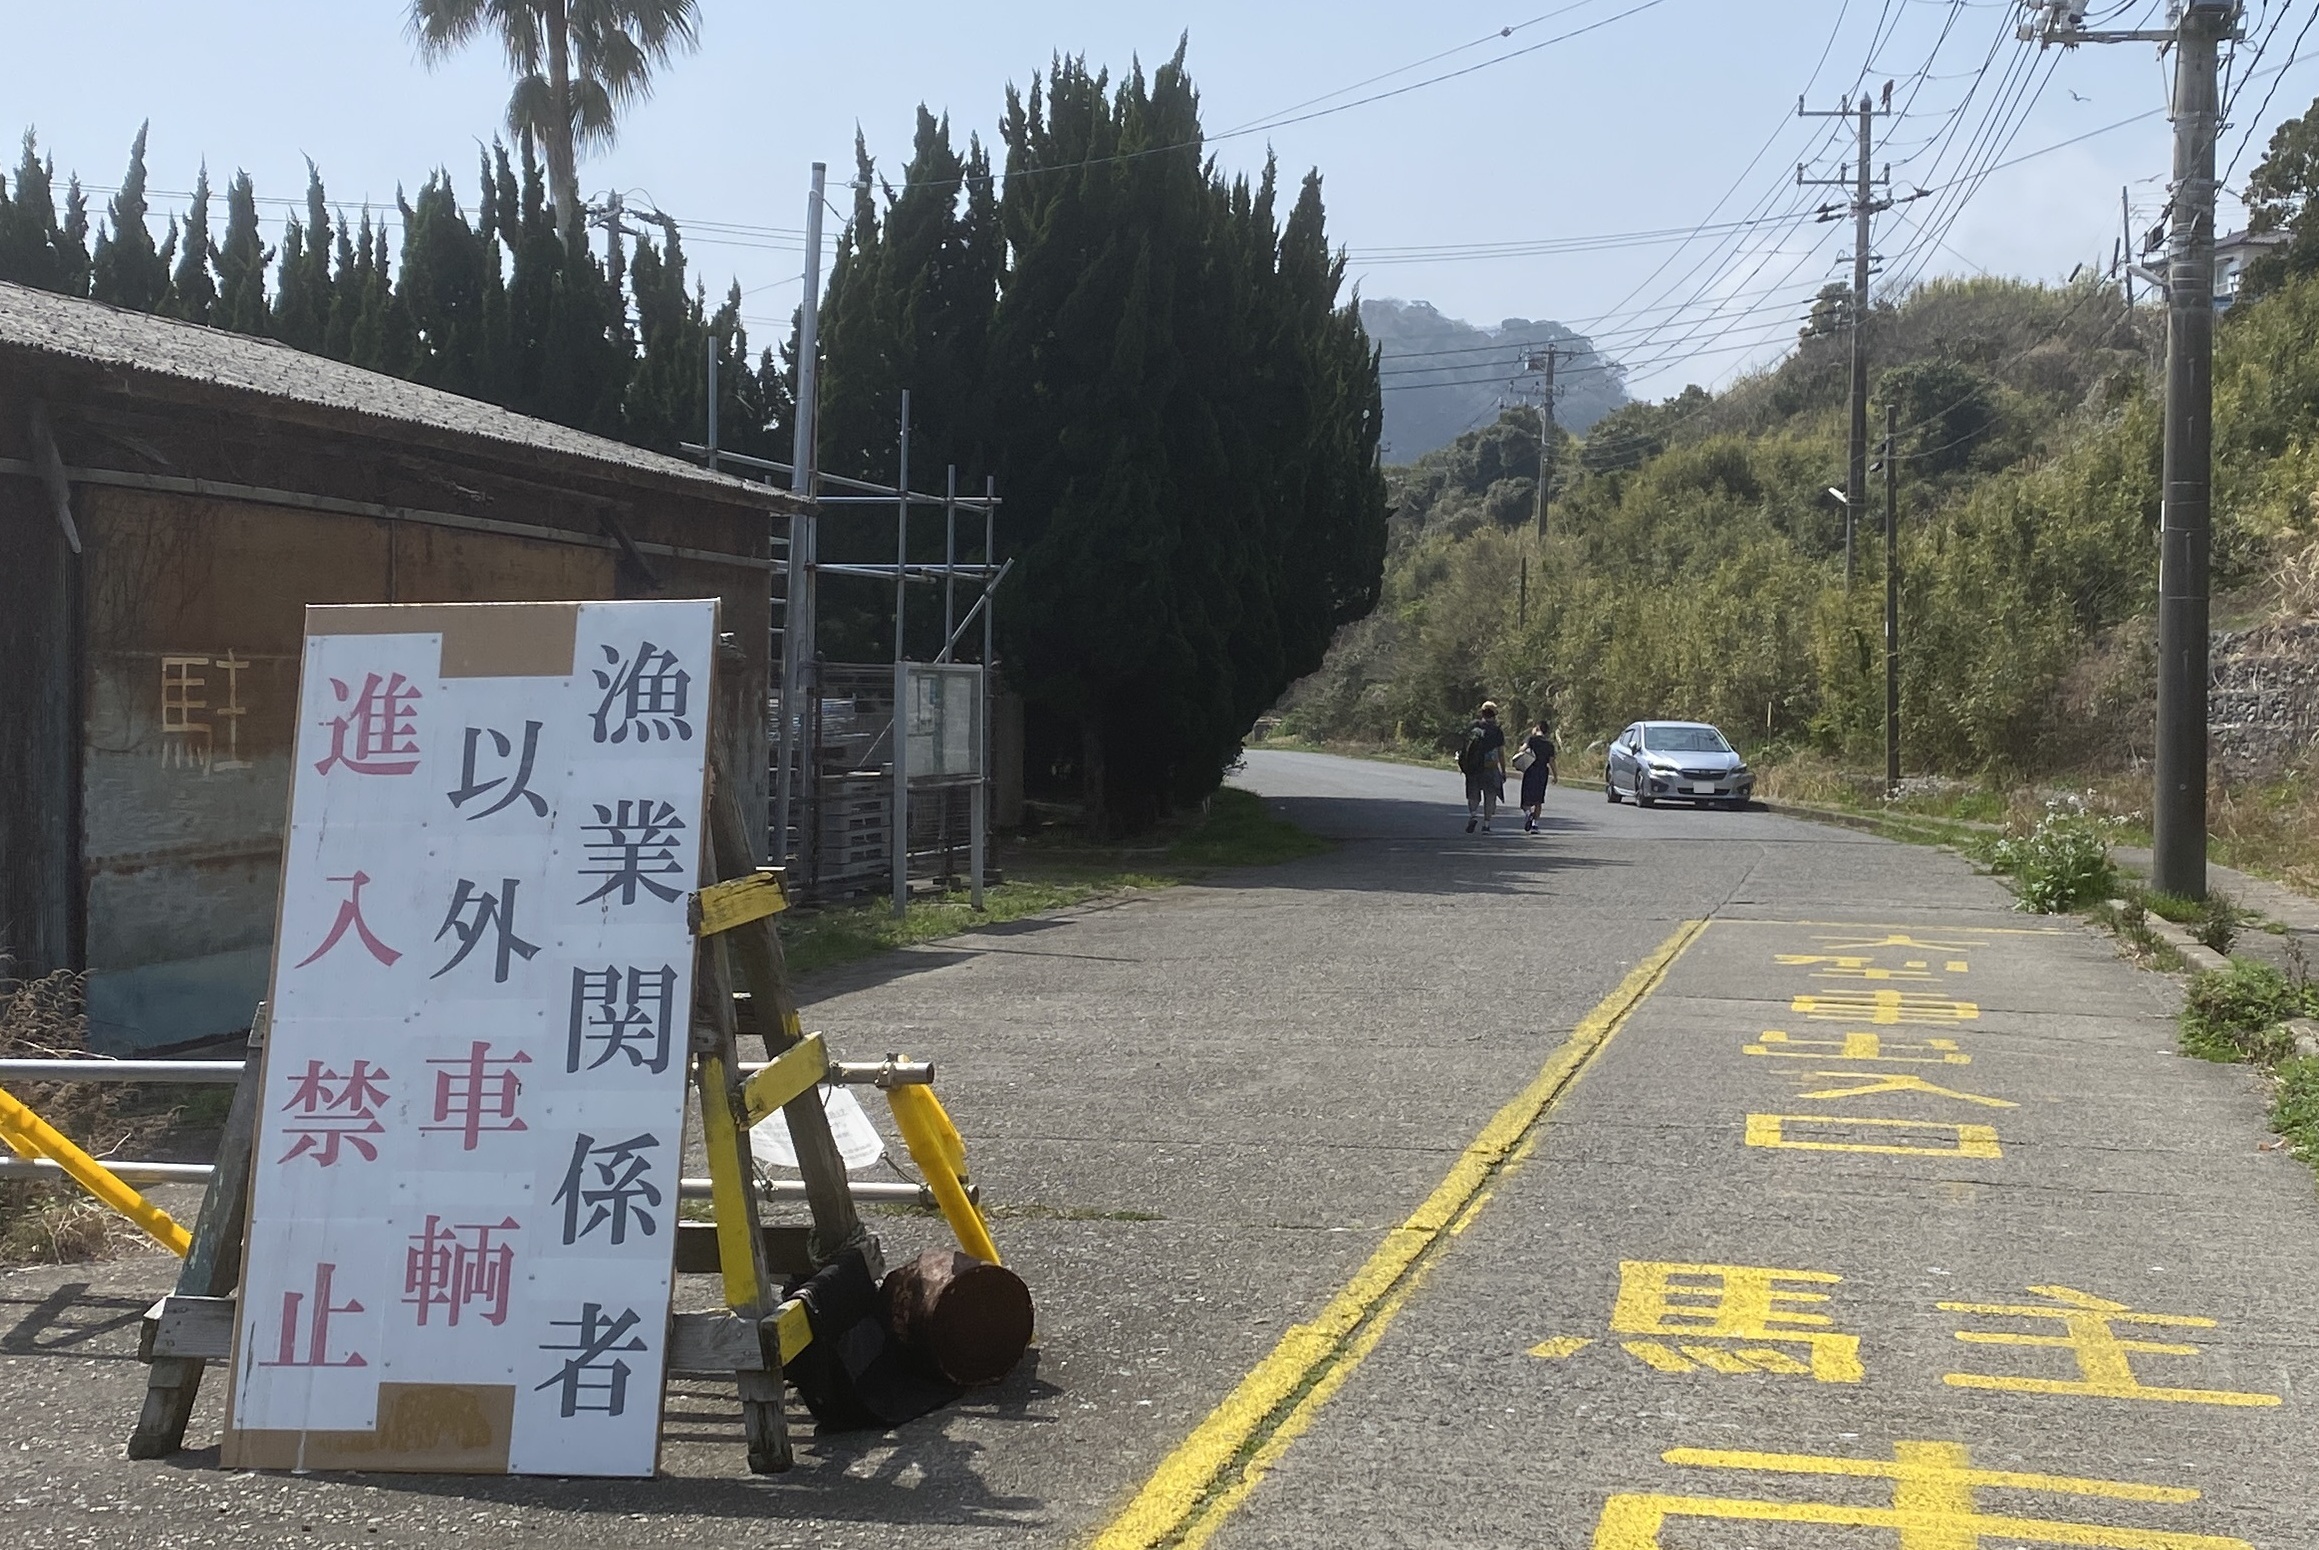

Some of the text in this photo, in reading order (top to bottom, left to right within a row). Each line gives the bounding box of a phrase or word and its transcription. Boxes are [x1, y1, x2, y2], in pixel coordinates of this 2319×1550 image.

[257, 671, 424, 1368] 進入禁止
[534, 641, 693, 1418] 漁業関係者
